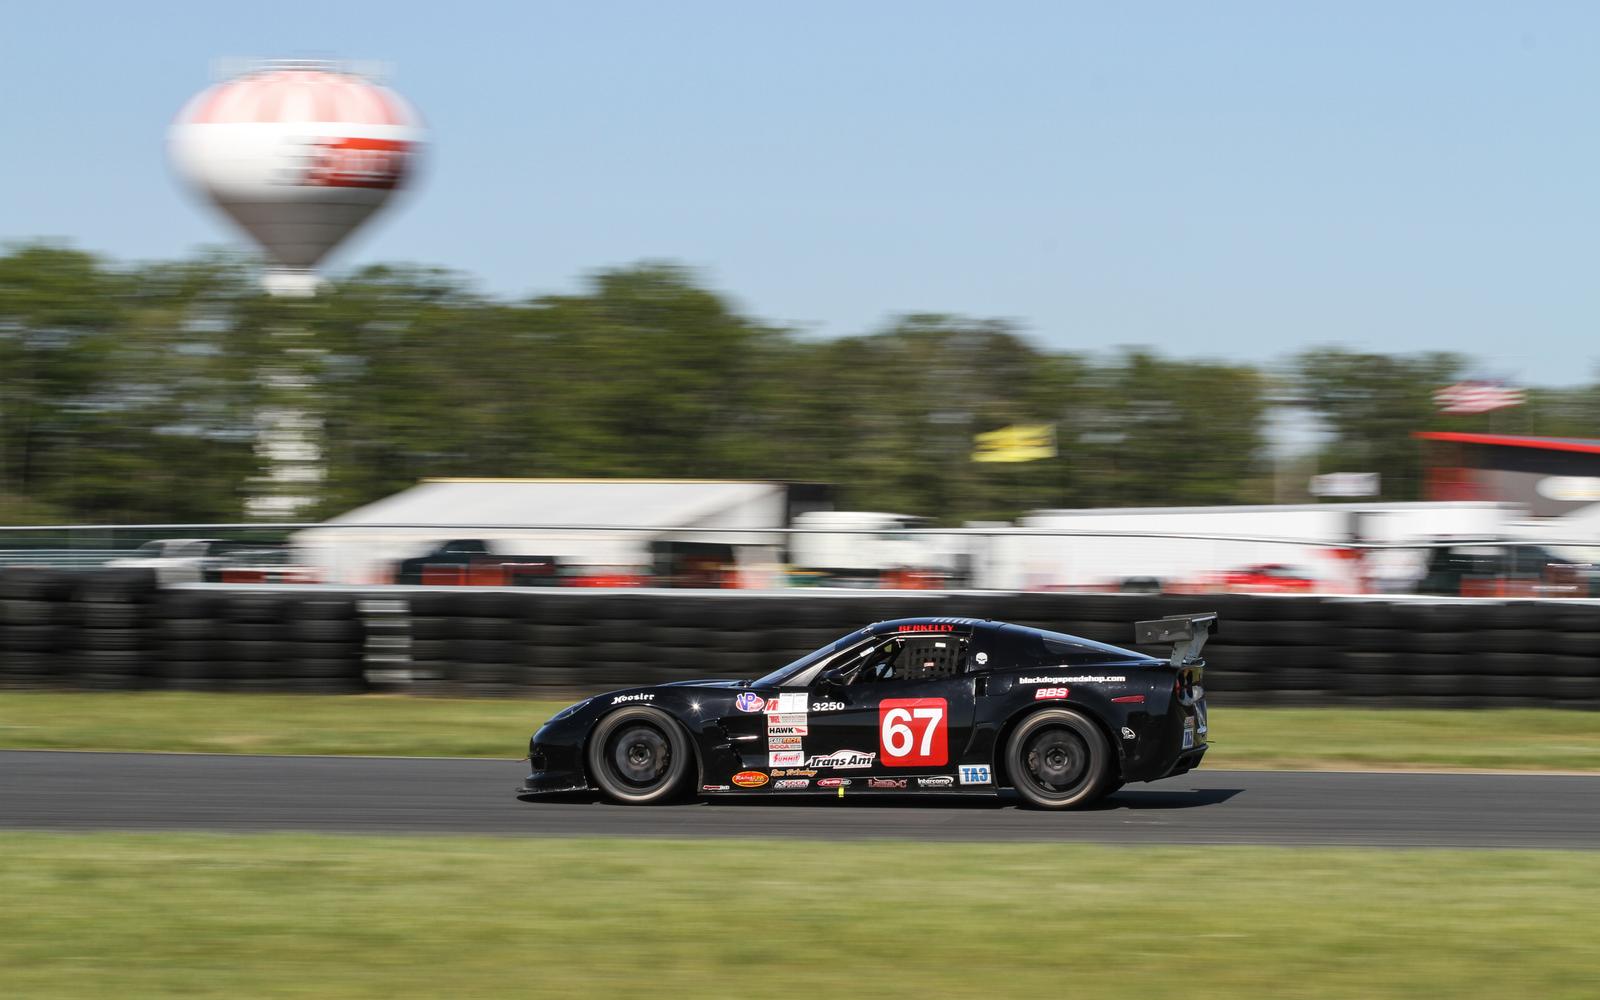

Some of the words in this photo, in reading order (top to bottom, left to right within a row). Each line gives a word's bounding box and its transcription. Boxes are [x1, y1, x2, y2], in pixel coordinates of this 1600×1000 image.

[898, 624, 954, 632] BERKELEY
[1019, 675, 1126, 685] blackdogspeedshop.com
[611, 693, 655, 705] Hoosier
[1035, 688, 1069, 699] BBS
[736, 692, 757, 711] VP
[812, 702, 845, 712] 3250
[882, 708, 943, 757] 67
[810, 756, 846, 767] Trans
[848, 755, 872, 766] Am
[917, 777, 950, 785] Intercomp
[962, 768, 988, 783] TA3
